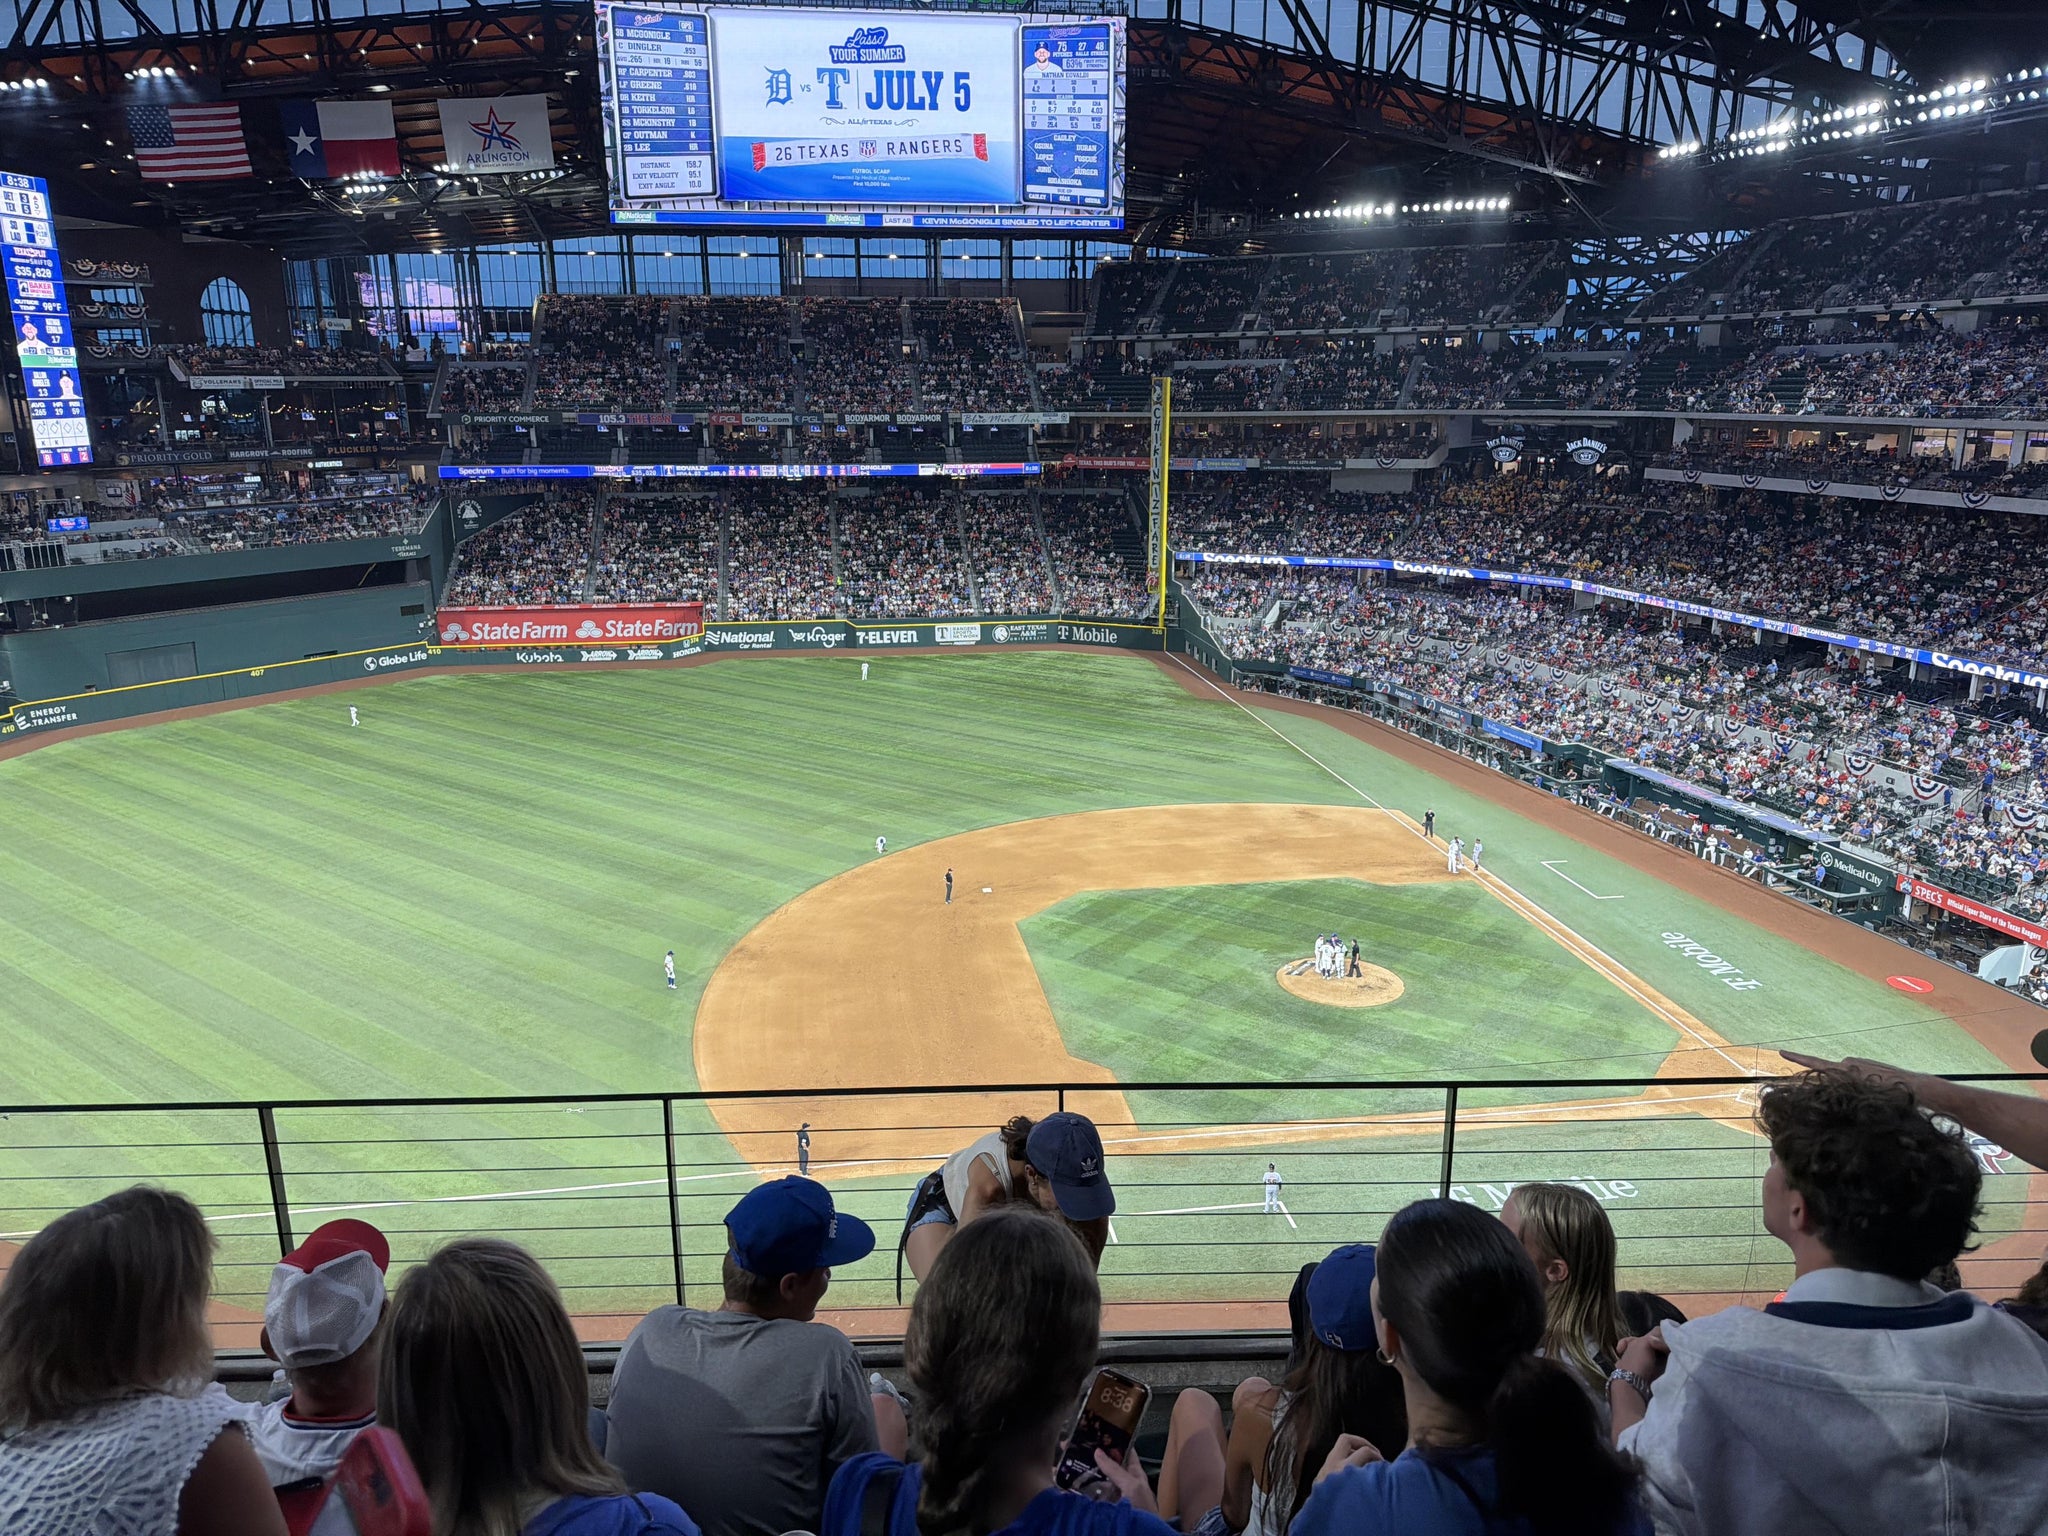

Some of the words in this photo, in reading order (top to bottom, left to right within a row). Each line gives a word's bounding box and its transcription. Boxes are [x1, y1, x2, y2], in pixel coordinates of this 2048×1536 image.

[627, 29, 670, 40] MCGONIGLE
[847, 28, 886, 48] Lasso
[628, 42, 662, 51] DINGLER
[1057, 42, 1067, 51] 75
[1078, 42, 1086, 50] 27
[832, 48, 857, 62] YOUR
[860, 48, 904, 62] SUMMER
[1066, 59, 1082, 68] 63%
[629, 68, 672, 77] CARPENTER
[630, 81, 662, 89] GREENE
[865, 69, 944, 111] JULY
[953, 71, 971, 112] 5
[632, 93, 656, 101] KEITH
[632, 106, 675, 114] TORKELSON
[633, 119, 675, 127] MCKINSTRY
[634, 131, 667, 139] OUTMAN
[635, 143, 650, 151] LEE
[776, 147, 792, 161] 26
[800, 144, 849, 159] TEXAS
[888, 139, 962, 155] RANGERS
[467, 151, 529, 163] ARLINGTON
[686, 160, 702, 169] 158.7
[7, 176, 29, 188] 8:38
[4, 191, 14, 200] DET
[21, 194, 27, 202] 3
[5, 202, 16, 212] TEX
[34, 201, 39, 209] 5
[1054, 219, 1110, 227] LEFT-CENTER
[599, 415, 626, 423] 105.3
[628, 415, 649, 423] THE
[651, 415, 672, 423] FAN
[845, 414, 890, 422] BODYARMOR
[897, 414, 941, 422] BODYARMOR
[964, 414, 988, 424] Blue
[990, 414, 1016, 423] Mint
[1486, 439, 1500, 450] JACK
[1500, 435, 1524, 451] DANIEL'S
[1566, 442, 1582, 453] JACK
[1582, 437, 1608, 453] DANIEL'S
[230, 450, 269, 458] HARGROVE
[282, 448, 313, 456] ROOFING
[327, 445, 378, 455] PLUCKERS
[130, 453, 180, 463] PRIORITY
[183, 451, 212, 461] GOLD
[1151, 517, 1160, 568] FARE
[720, 631, 774, 643] National
[807, 626, 846, 648] Kroger
[1072, 626, 1118, 644] Mobile
[516, 652, 564, 663] Kubota
[673, 647, 701, 659] HONDA
[379, 653, 407, 667] Globe
[409, 650, 427, 662] Life
[250, 669, 264, 677] 407
[1394, 689, 1413, 701] American
[30, 706, 66, 718] ENERGY
[1439, 705, 1460, 719] American
[32, 713, 78, 726] TRANSFER
[1, 725, 15, 734] 410
[1834, 858, 1865, 879] Medical
[1865, 871, 1883, 887] City
[1915, 885, 1943, 904] SPEC'S
[1998, 918, 2006, 927] the
[2007, 921, 2021, 933] Texas
[2021, 927, 2042, 940] Rangers
[1661, 932, 1743, 975] Mobile
[1101, 1387, 1134, 1414] 8:38
